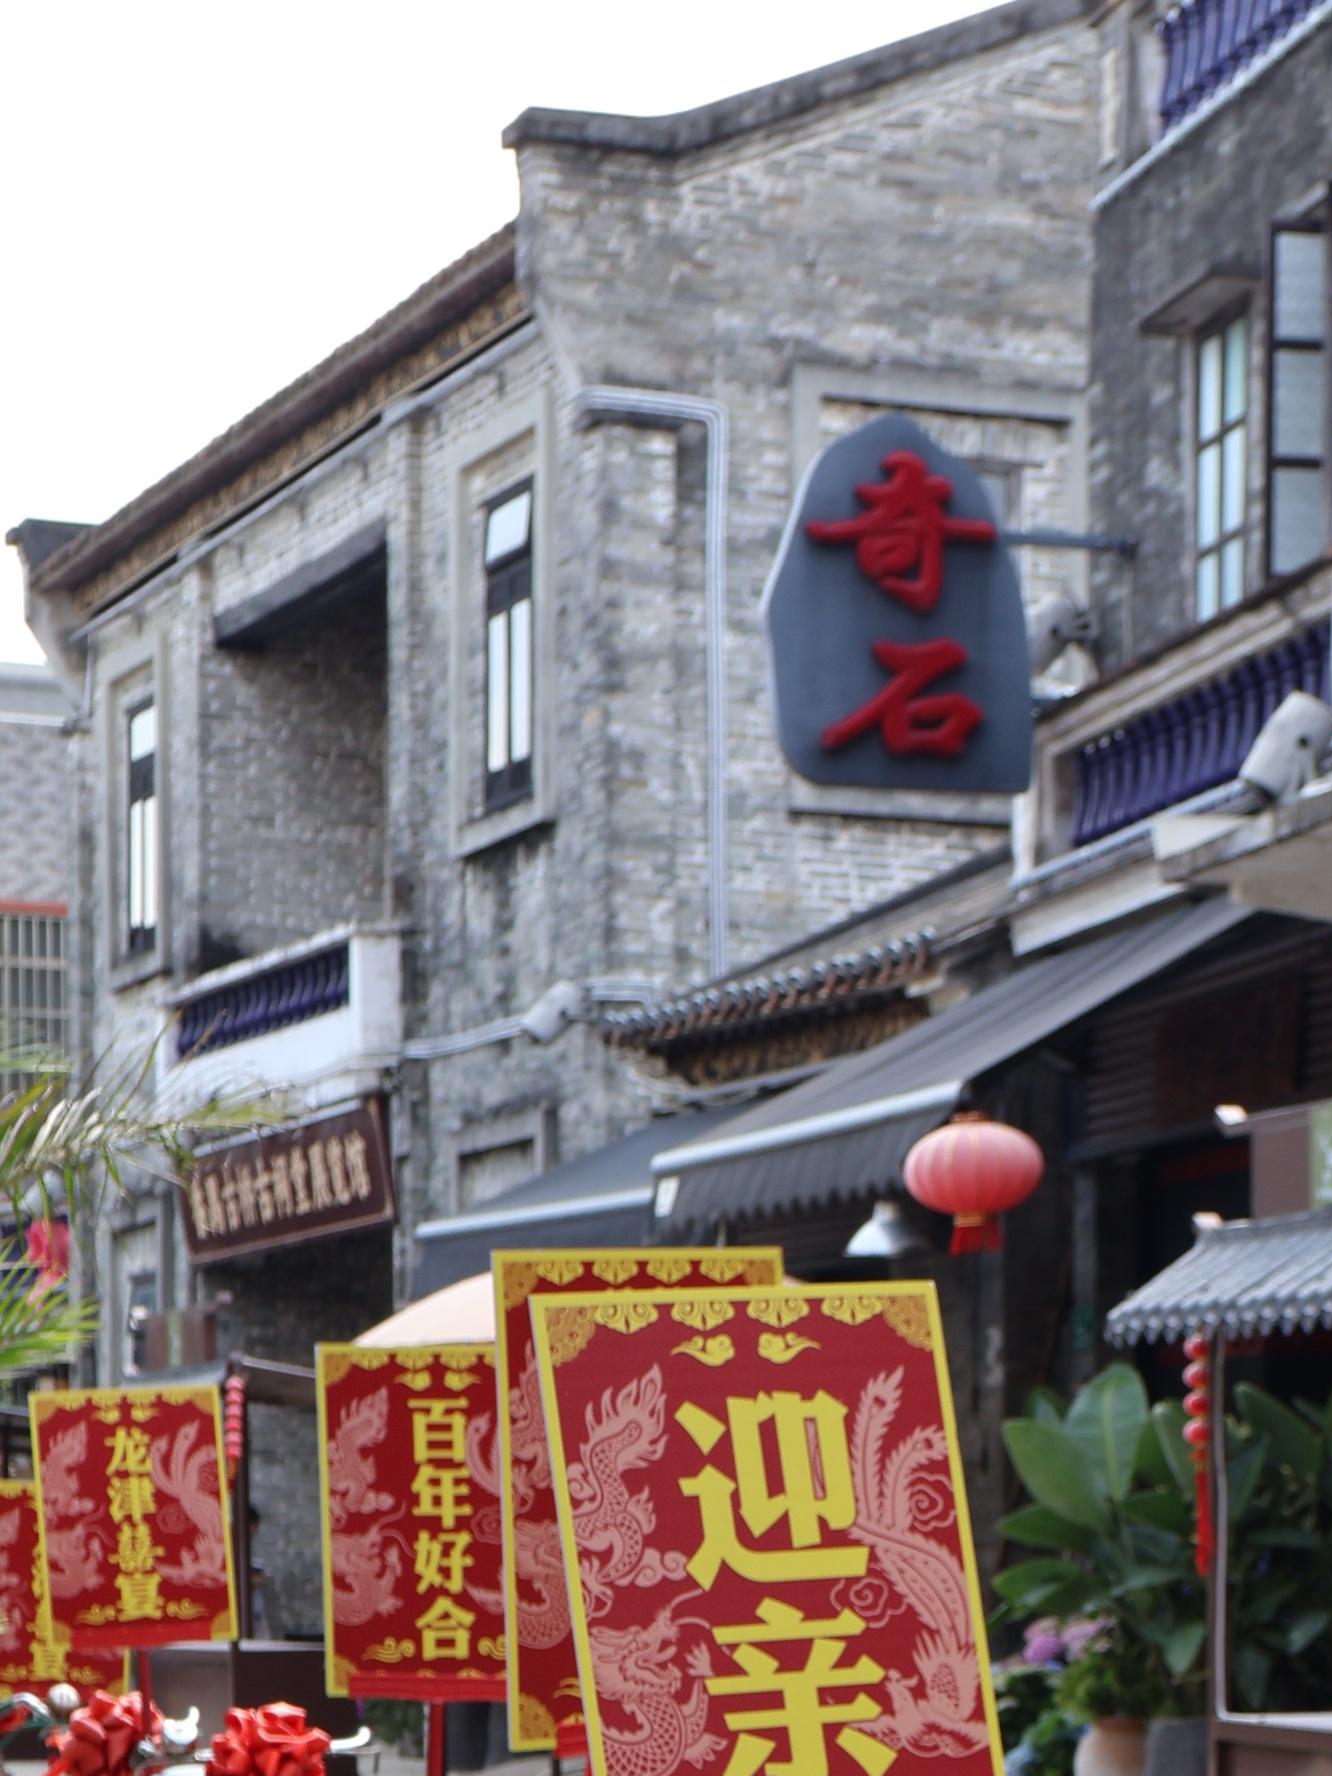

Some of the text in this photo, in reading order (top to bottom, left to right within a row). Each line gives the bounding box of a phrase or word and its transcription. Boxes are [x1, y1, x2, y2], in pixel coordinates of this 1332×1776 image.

[804, 449, 999, 758] 奇石
[406, 1396, 475, 1662] 百年好合
